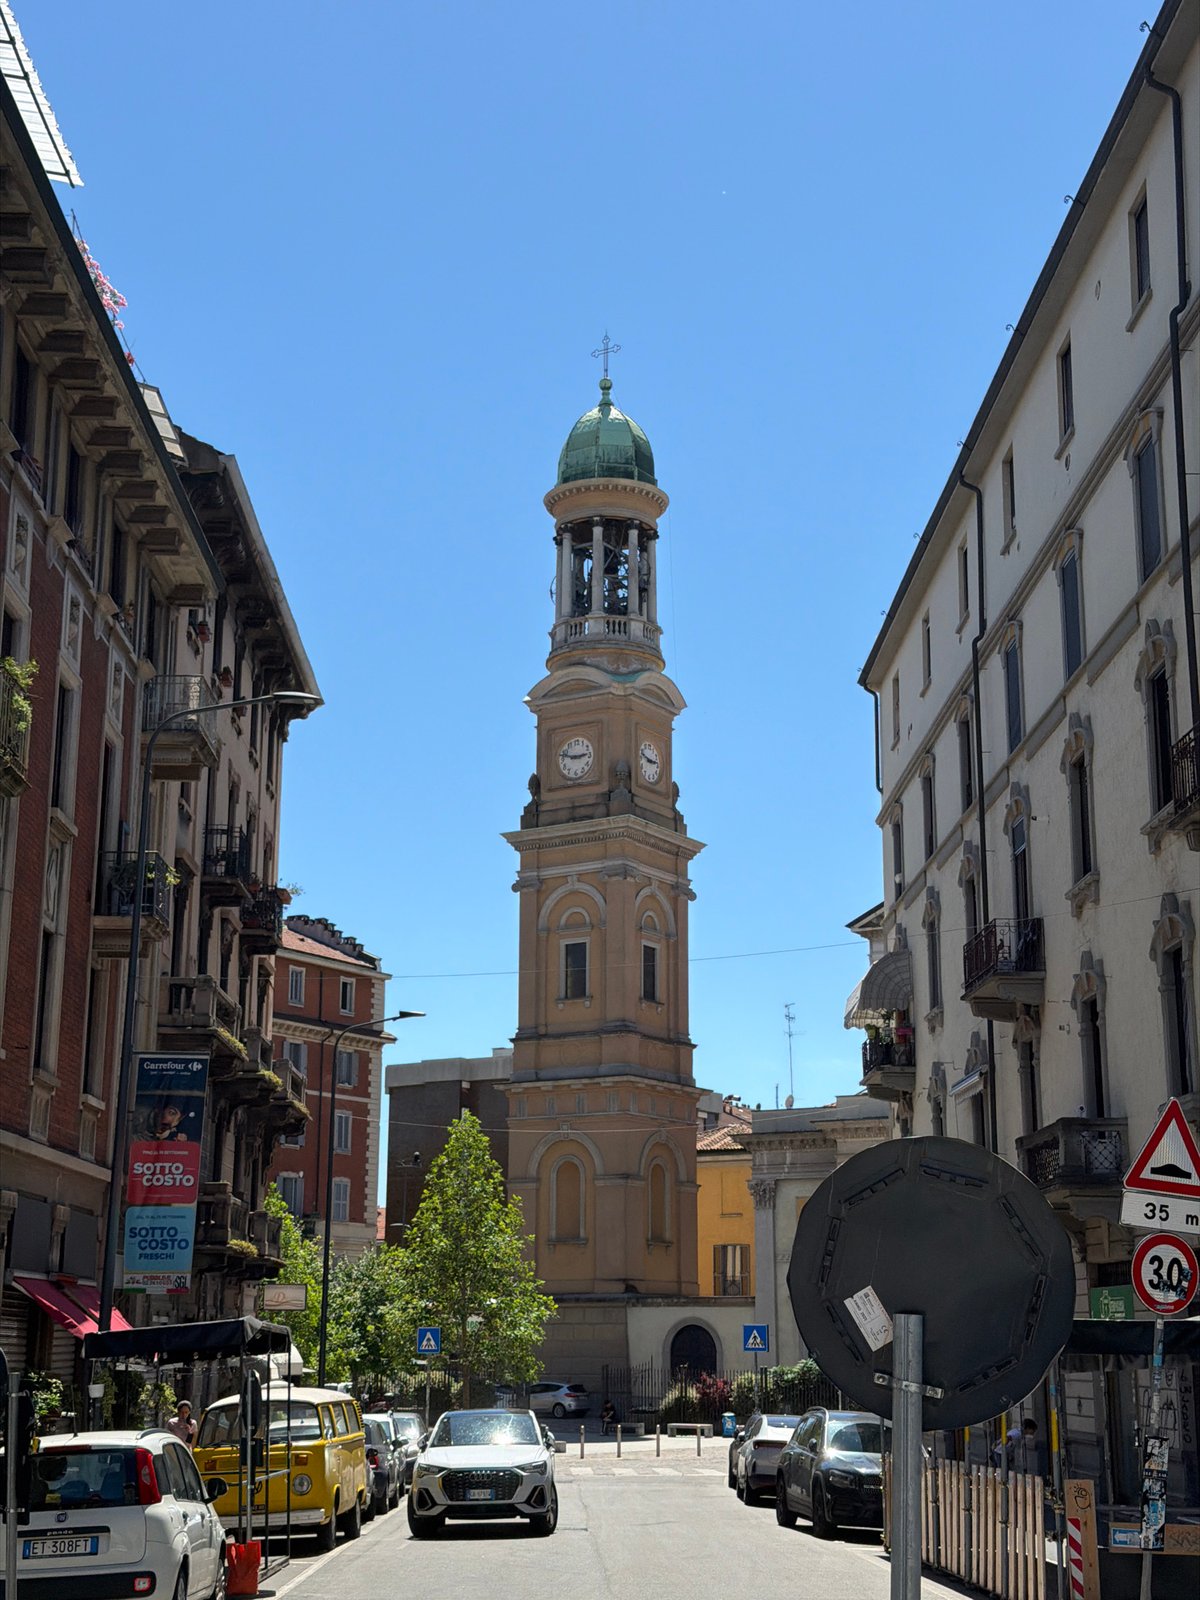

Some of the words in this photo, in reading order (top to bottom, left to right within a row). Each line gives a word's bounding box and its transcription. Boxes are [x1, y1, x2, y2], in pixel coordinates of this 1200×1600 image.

[144, 1061, 186, 1070] Carrefour
[133, 1162, 184, 1175] SOTTO
[142, 1174, 195, 1187] COSTO
[1144, 1202, 1170, 1222] 35
[1185, 1213, 1199, 1226] m
[128, 1226, 179, 1239] SOTTO
[137, 1238, 190, 1251] COSTO
[138, 1252, 175, 1260] FRESCHI
[1148, 1254, 1183, 1292] 30
[31, 1541, 47, 1555] ET
[51, 1539, 89, 1554] 308FT
